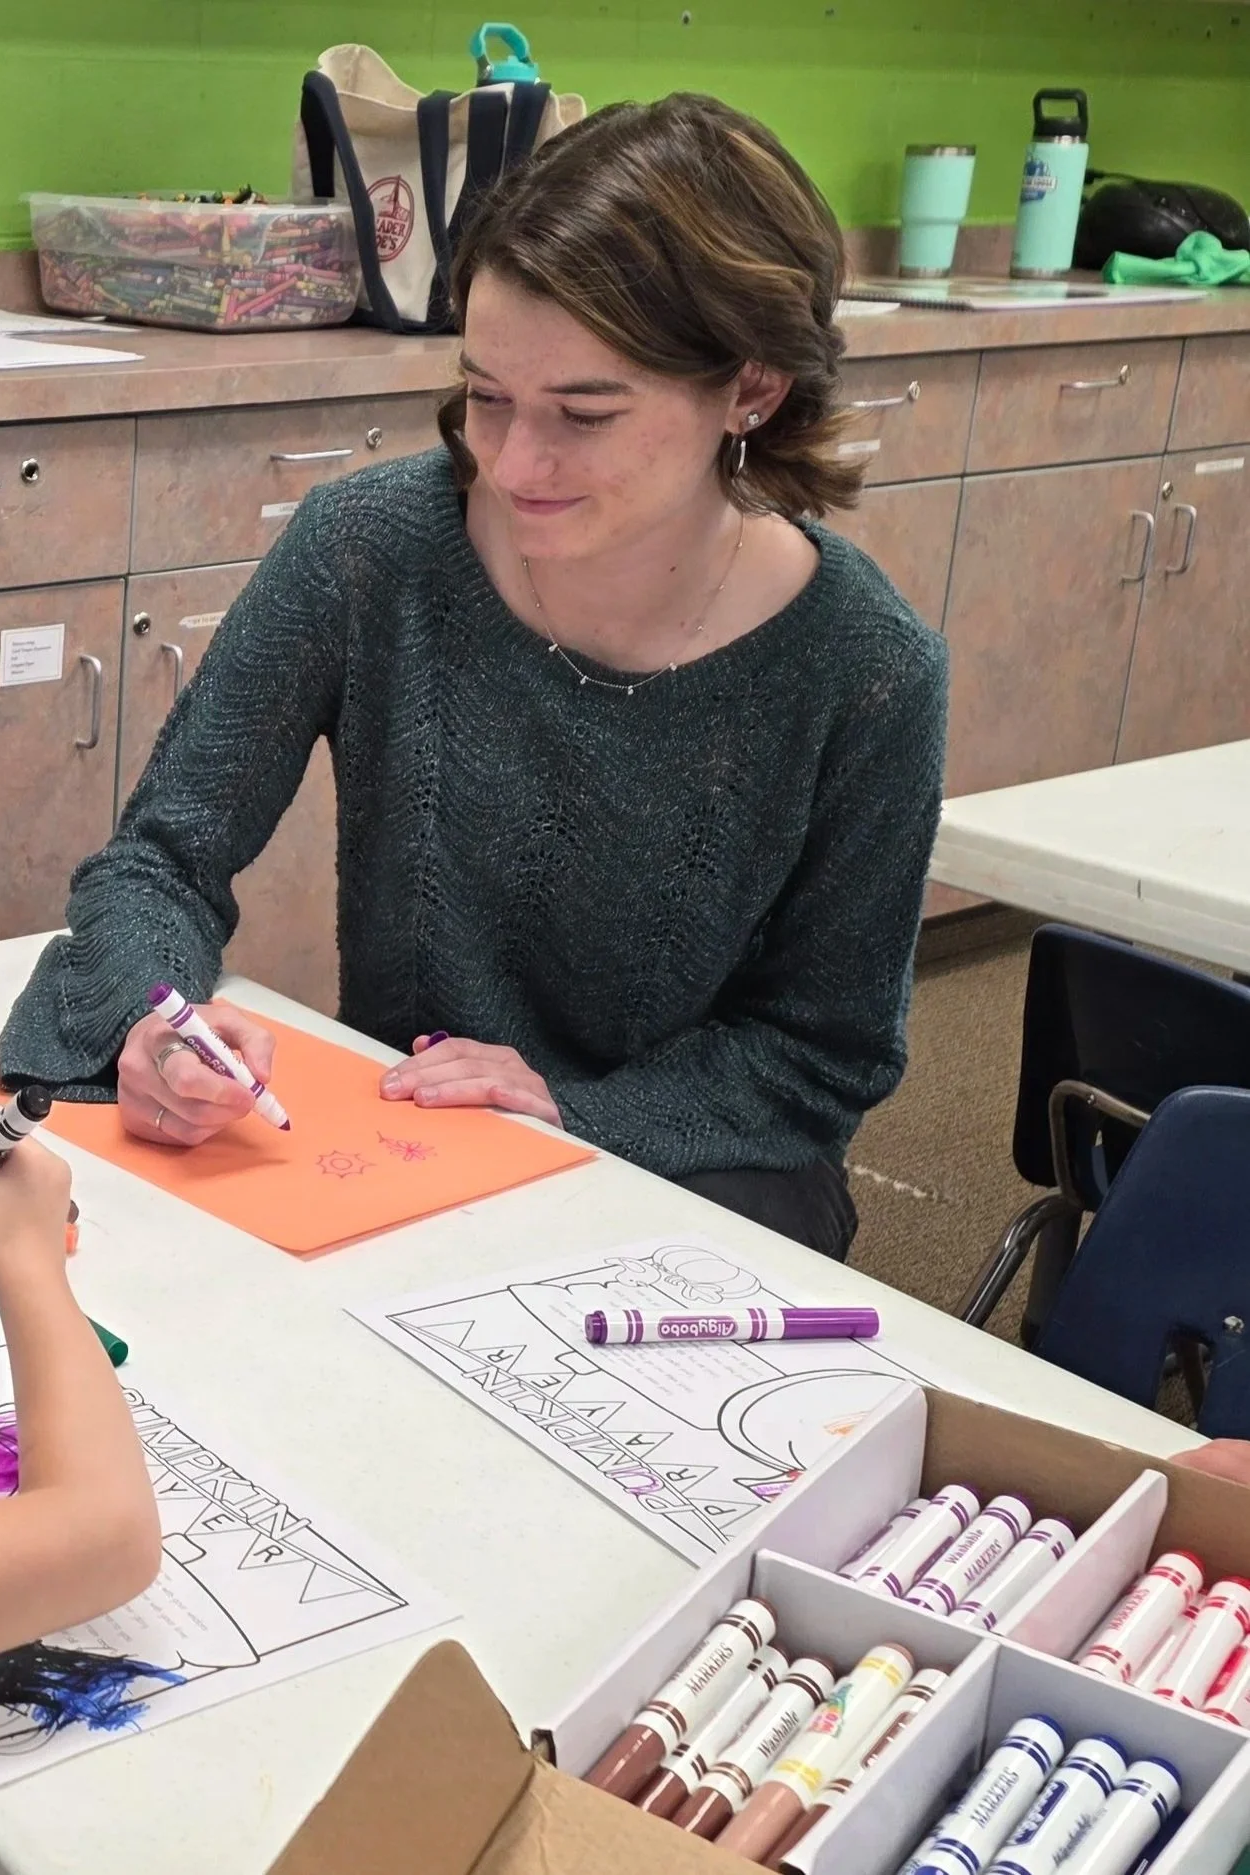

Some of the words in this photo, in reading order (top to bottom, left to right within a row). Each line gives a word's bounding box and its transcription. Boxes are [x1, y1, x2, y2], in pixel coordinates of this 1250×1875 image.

[377, 219, 406, 237] ADER
[377, 235, 398, 250] OE'S
[661, 1318, 735, 1337] Aigybobo
[461, 1364, 696, 1514] PUMPKIN
[945, 1528, 983, 1564] Washable
[963, 1539, 1003, 1584] MARKERS
[685, 1642, 734, 1696] MARKERS
[758, 1709, 800, 1759] Washable
[970, 1766, 1019, 1829] MARKERS
